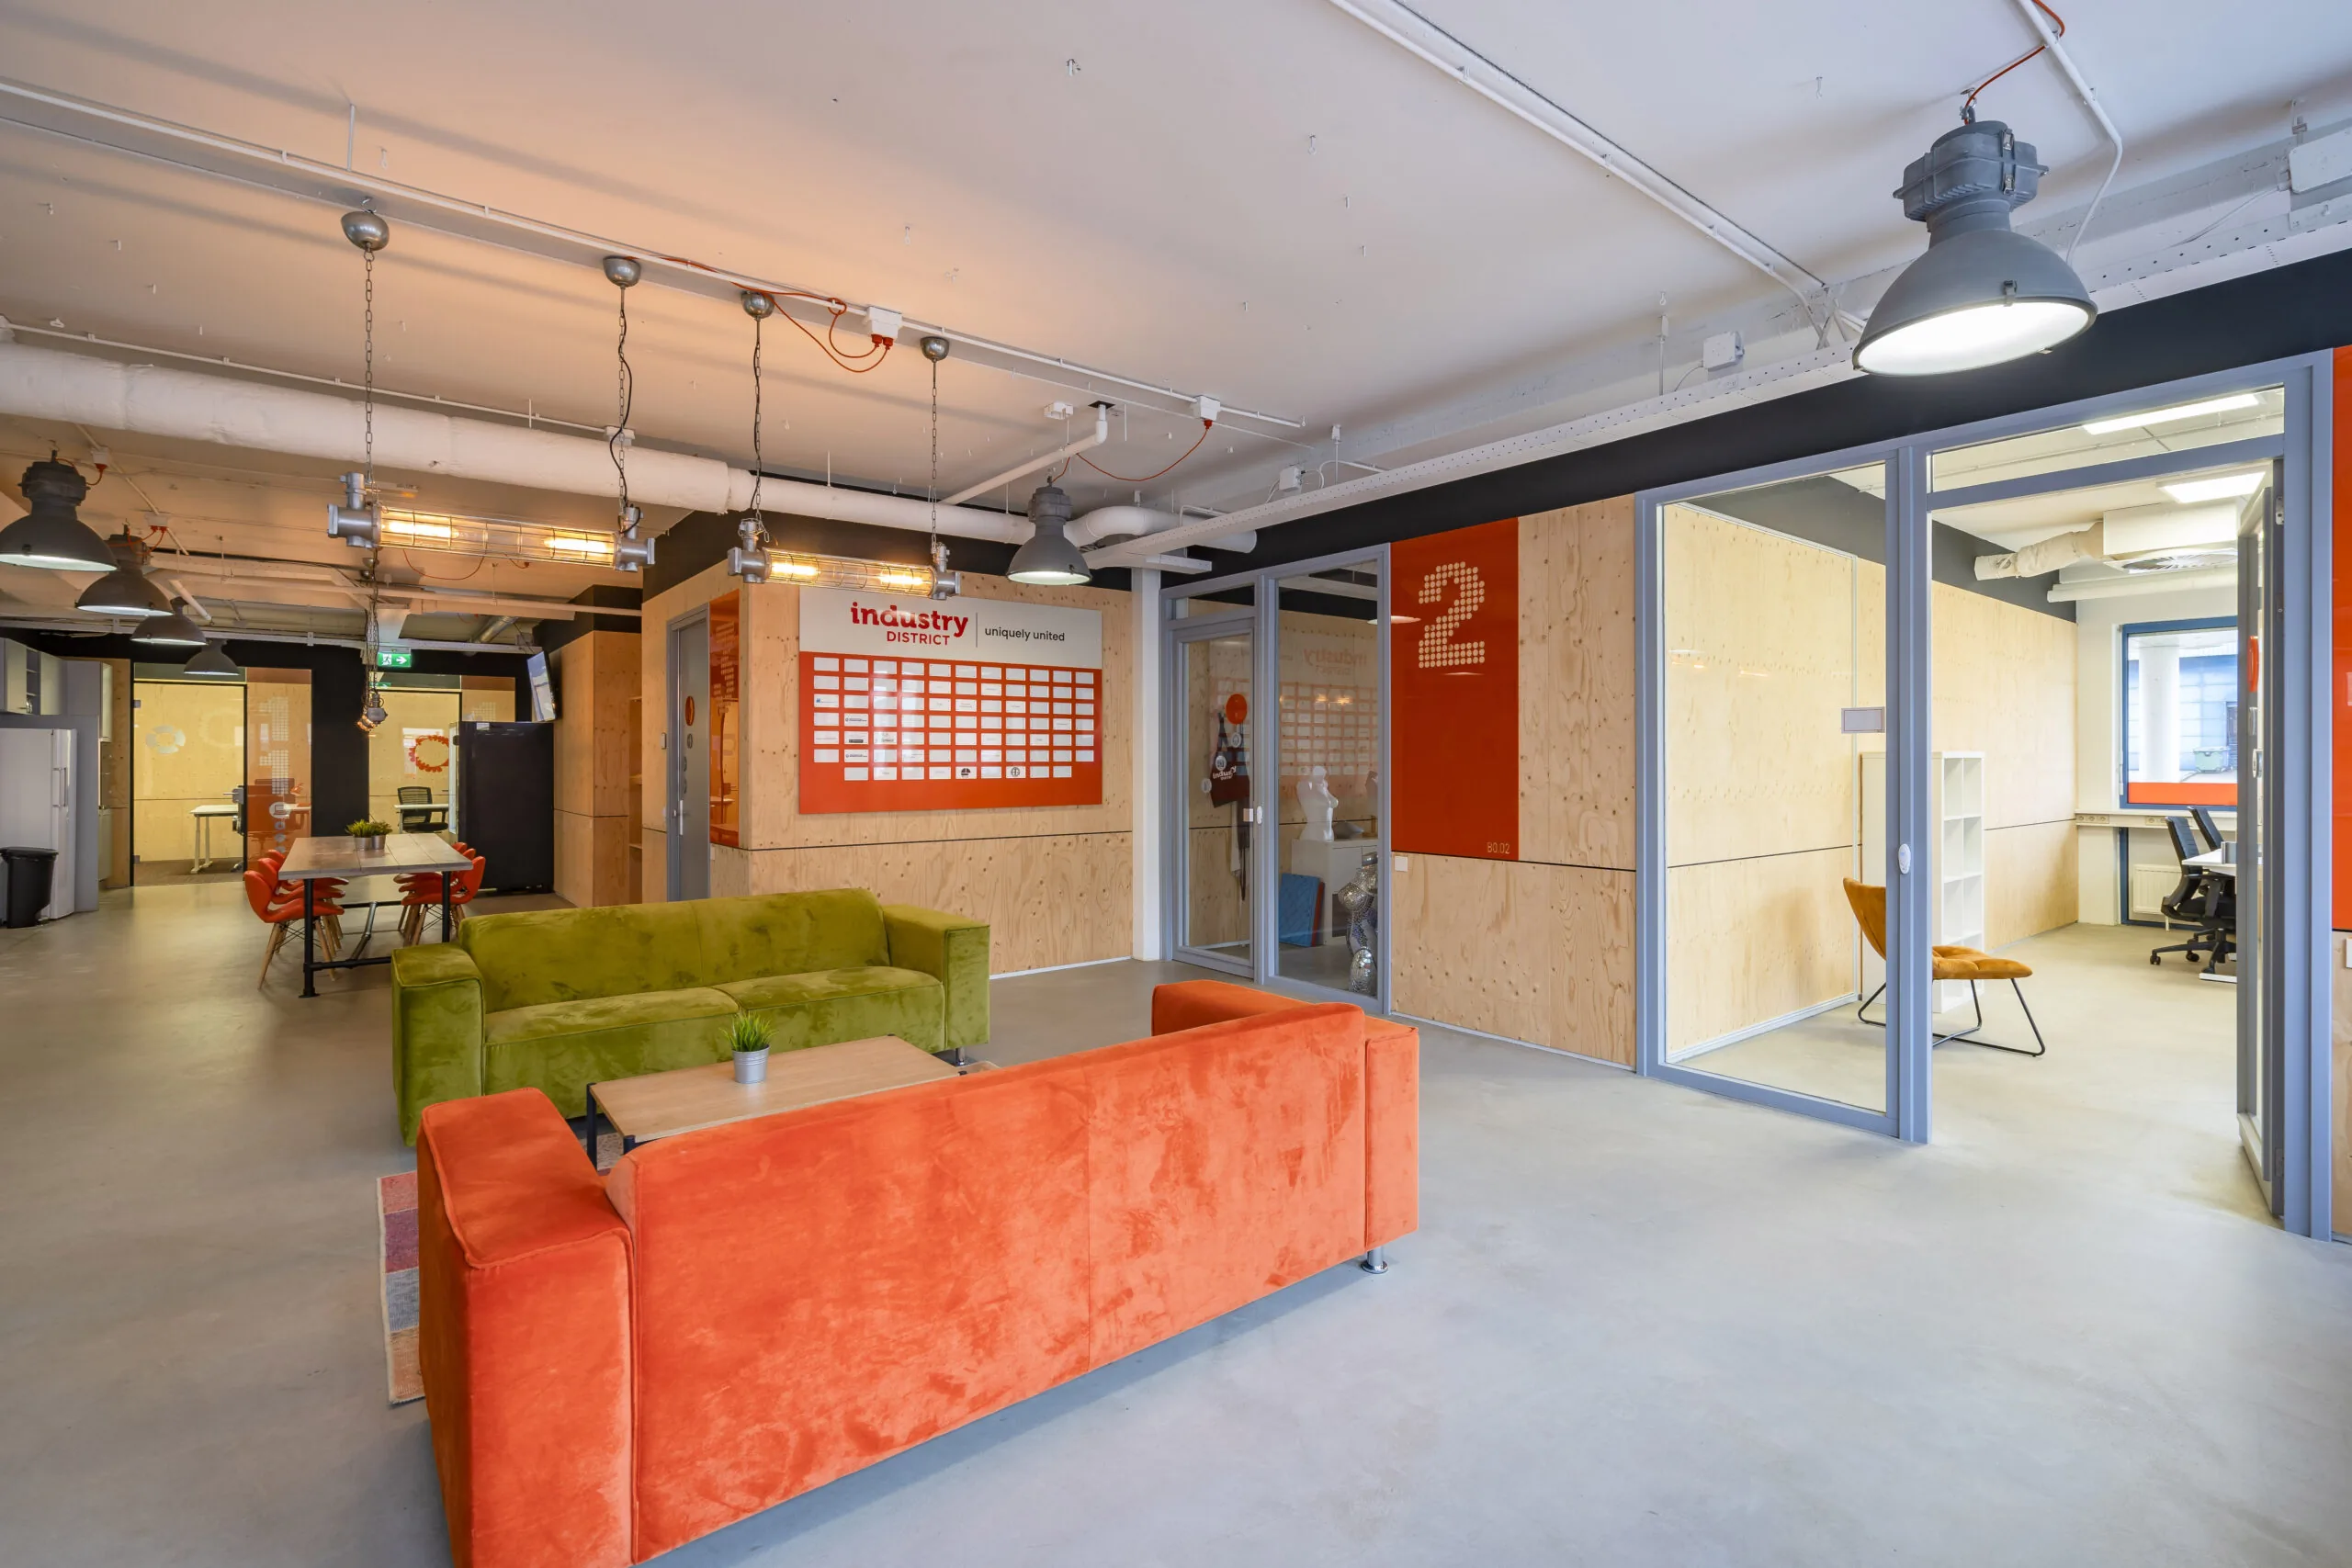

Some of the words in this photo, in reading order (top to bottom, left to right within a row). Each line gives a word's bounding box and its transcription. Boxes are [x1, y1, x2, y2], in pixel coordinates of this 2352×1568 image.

[850, 602, 968, 637] industry
[1419, 561, 1485, 669] 2
[887, 630, 950, 646] DISTRICT
[985, 626, 1031, 641] uniquely
[1034, 630, 1065, 641] united
